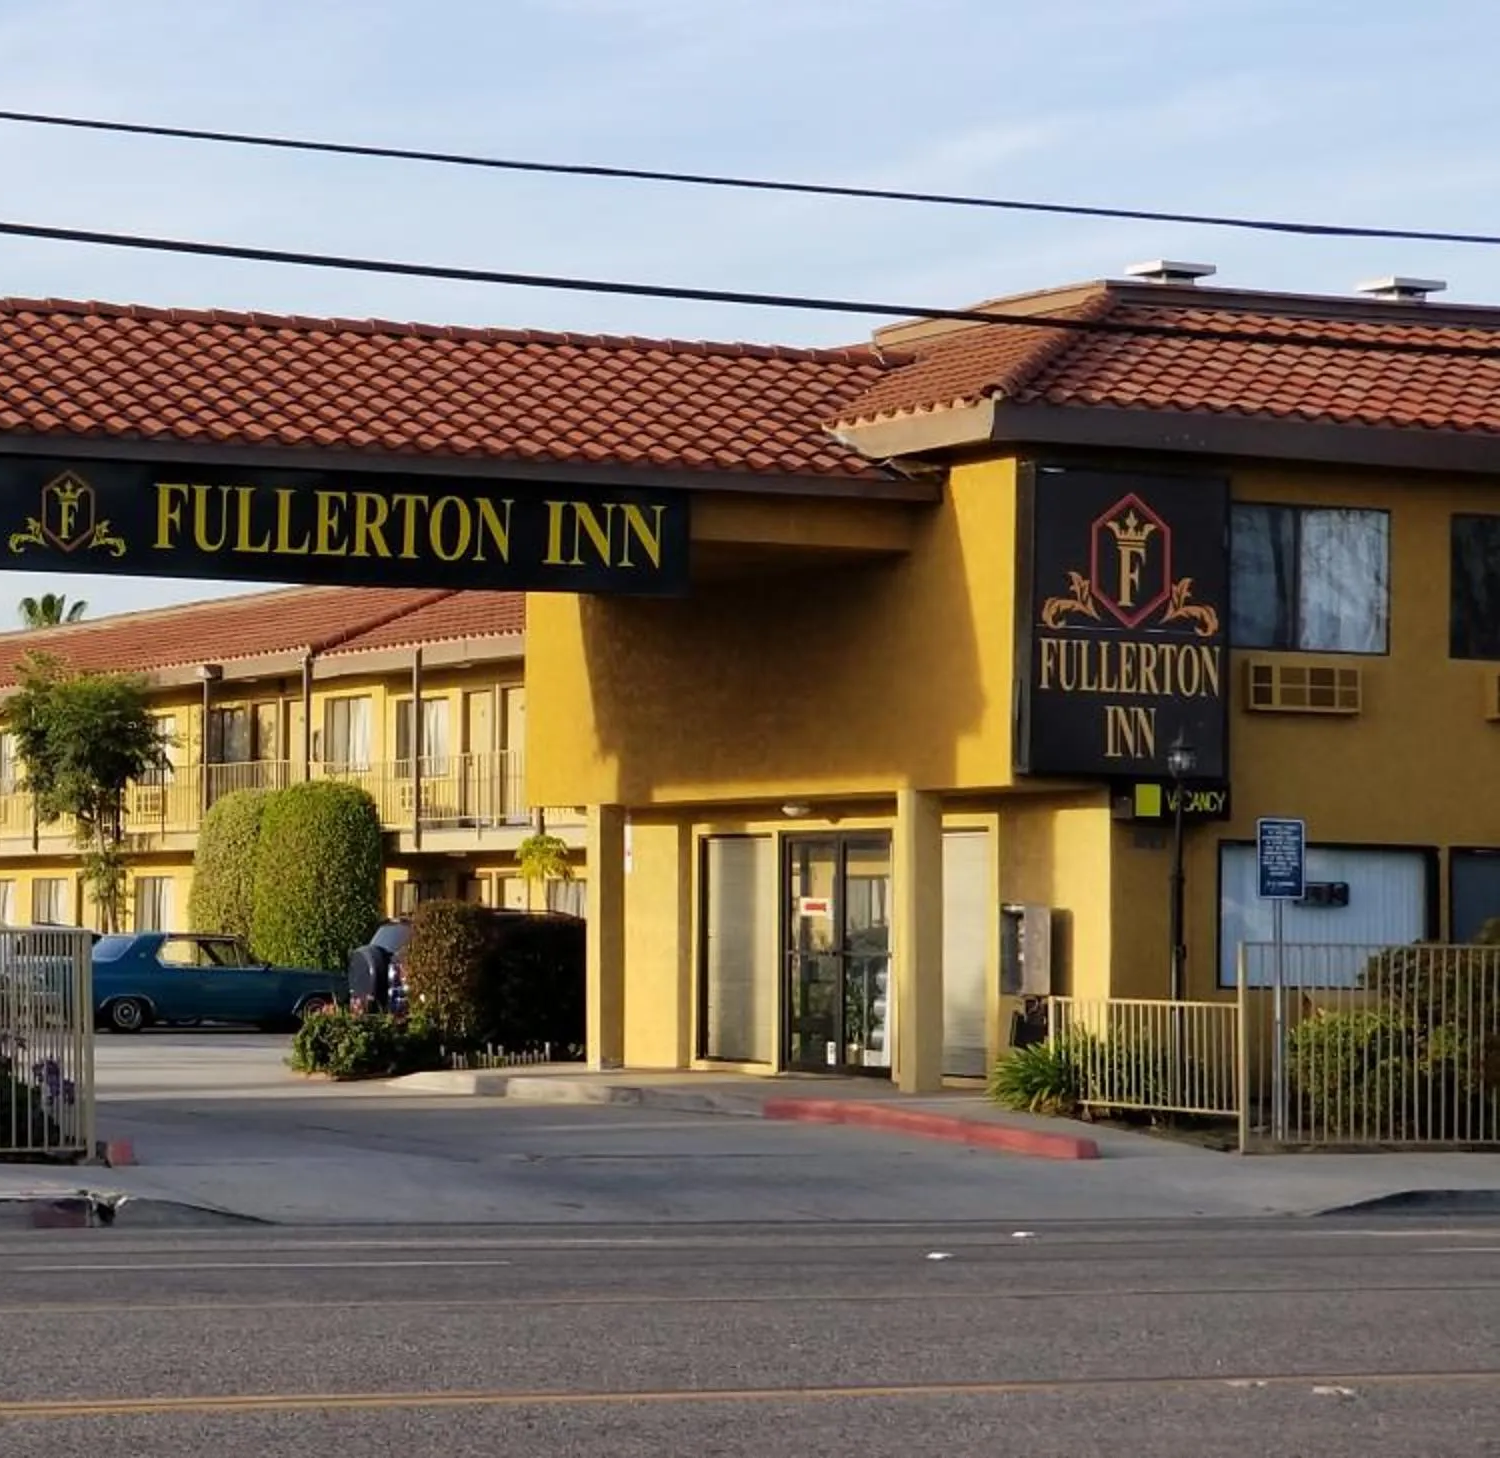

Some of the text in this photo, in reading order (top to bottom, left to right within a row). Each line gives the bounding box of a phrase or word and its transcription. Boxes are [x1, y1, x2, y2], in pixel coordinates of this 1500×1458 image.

[60, 501, 87, 540] F
[153, 482, 667, 569] FULLERTON INN
[1117, 545, 1147, 608] F
[1039, 637, 1220, 697] FULLERTON
[1104, 705, 1157, 759] INN
